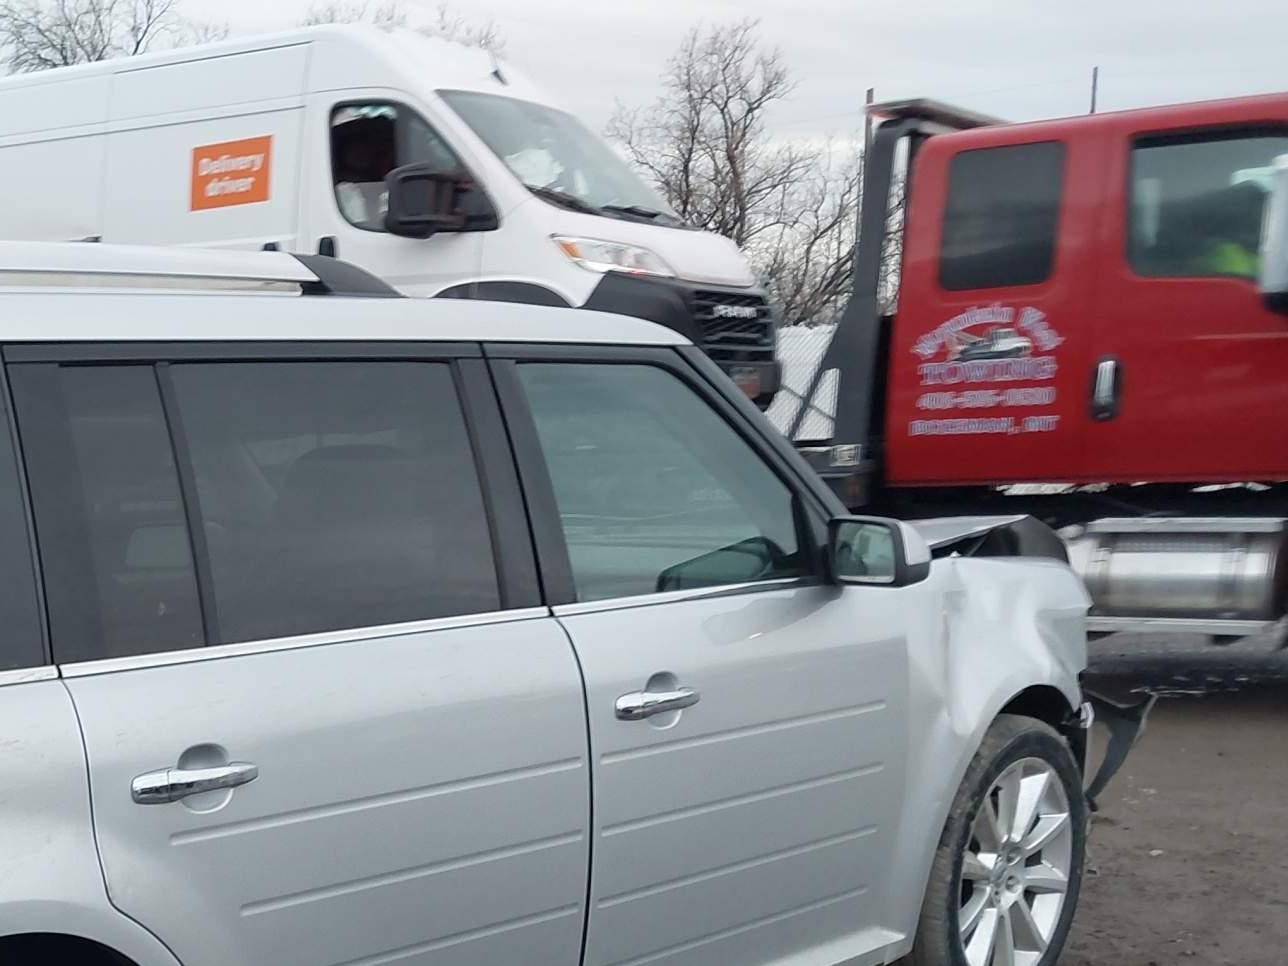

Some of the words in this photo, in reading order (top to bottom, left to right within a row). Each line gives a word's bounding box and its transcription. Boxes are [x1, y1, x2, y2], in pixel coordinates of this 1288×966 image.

[198, 153, 265, 176] Delivery
[205, 176, 256, 197] driver
[919, 356, 1058, 385] TOWING
